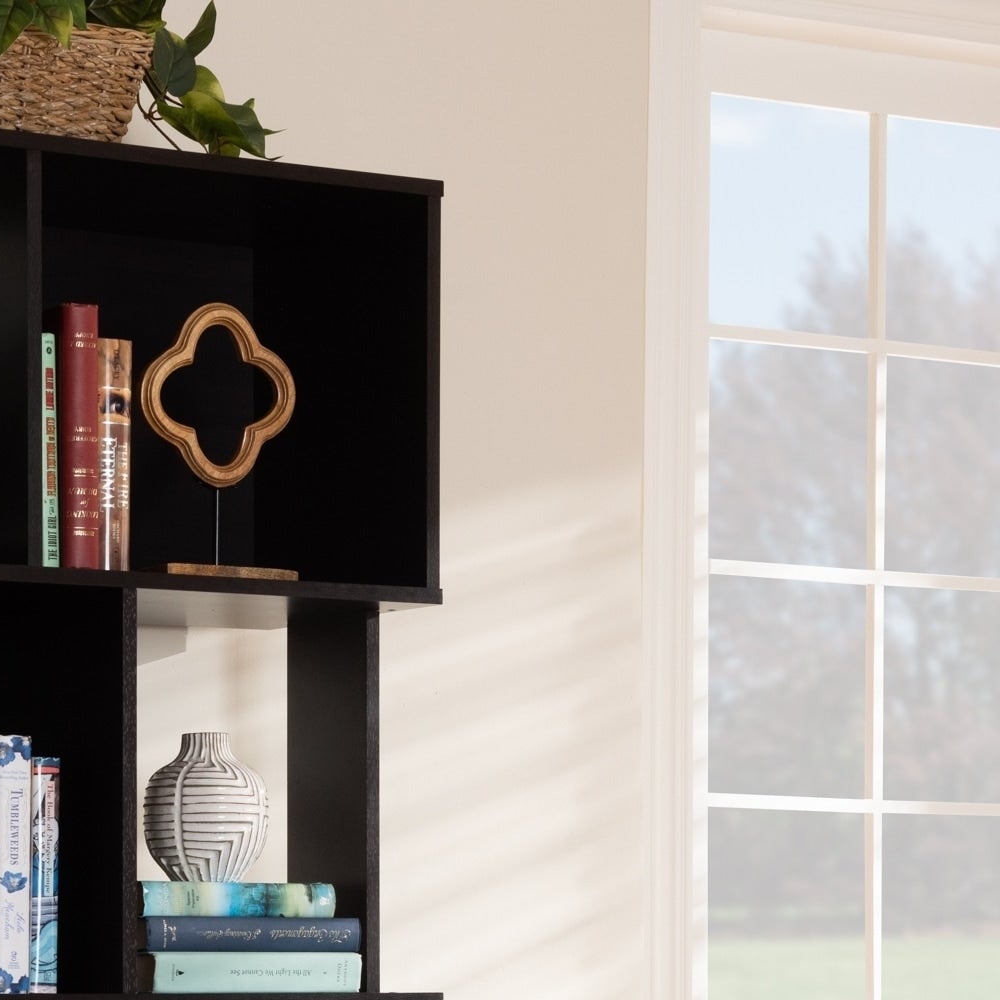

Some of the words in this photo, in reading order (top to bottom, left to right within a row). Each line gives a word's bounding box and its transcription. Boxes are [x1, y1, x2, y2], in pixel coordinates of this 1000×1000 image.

[48, 516, 57, 529] GIRL
[48, 531, 57, 548] IDIOT
[48, 548, 57, 560] THE
[46, 785, 54, 798] The
[46, 800, 54, 819] Book
[46, 822, 53, 832] of
[275, 968, 292, 976] Light
